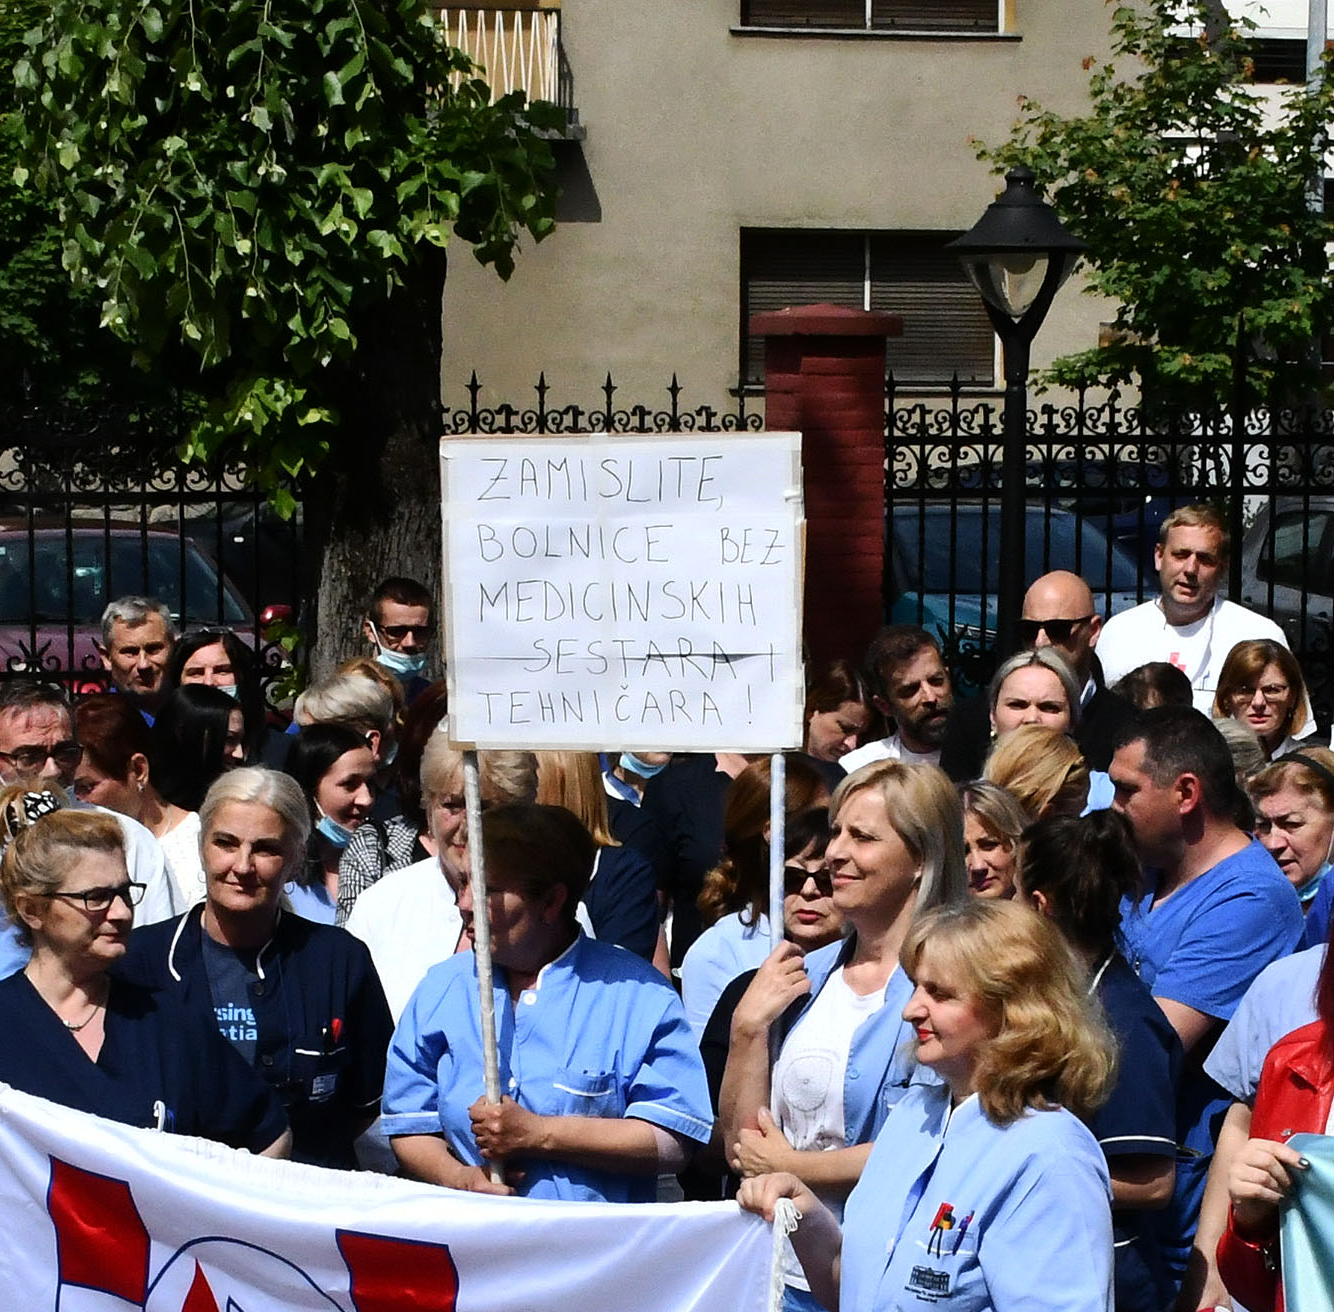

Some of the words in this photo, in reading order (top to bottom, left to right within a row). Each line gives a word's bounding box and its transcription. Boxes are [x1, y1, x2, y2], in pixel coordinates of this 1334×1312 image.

[477, 455, 724, 511] ZAMISLITE,
[477, 524, 673, 563] BOLNICE
[720, 527, 785, 565] BEZ
[479, 579, 756, 626] MEDICINSKIH
[523, 637, 737, 681] SESTARA
[213, 1002, 257, 1026] sing
